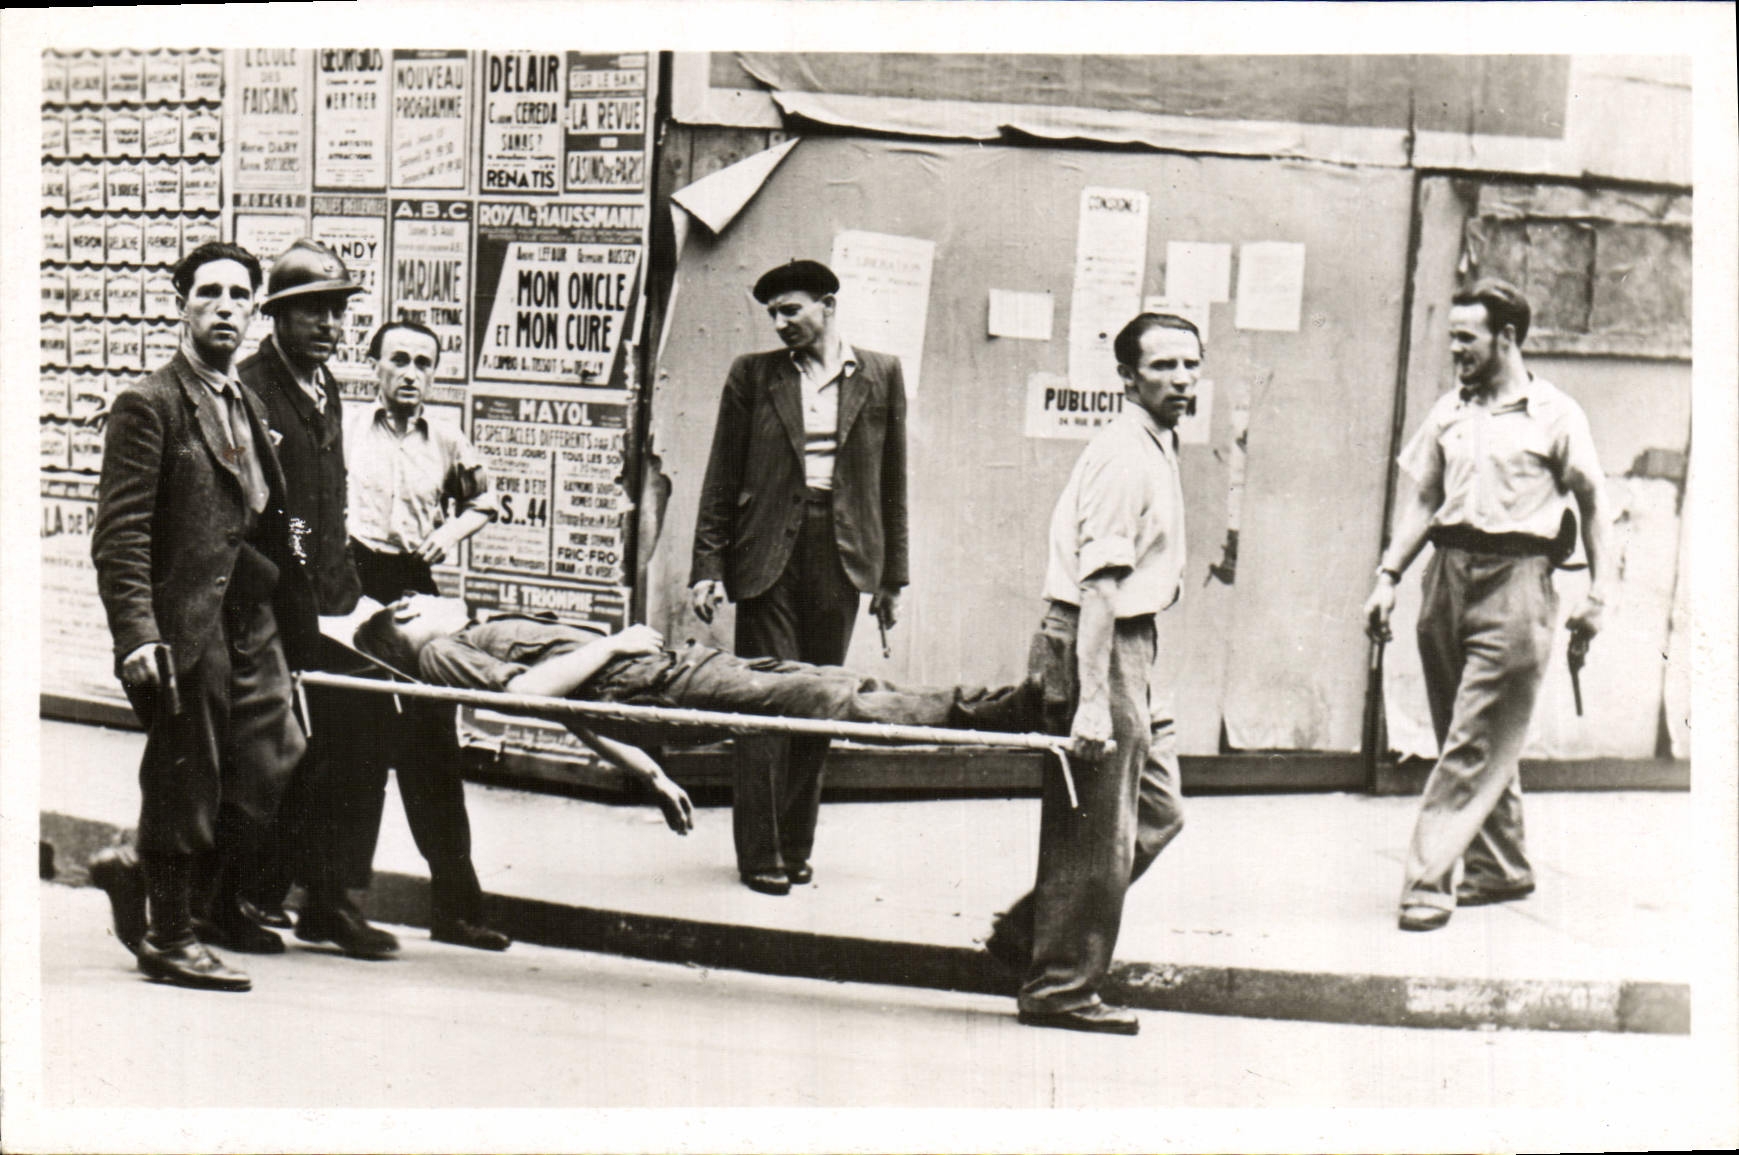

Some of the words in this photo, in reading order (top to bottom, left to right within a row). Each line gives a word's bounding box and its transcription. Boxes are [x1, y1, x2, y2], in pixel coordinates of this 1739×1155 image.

[396, 65, 464, 90] NOUVEAU
[489, 55, 560, 93] DELAIR
[242, 87, 298, 115] FAISANS
[325, 91, 377, 110] WERTHER
[396, 96, 463, 119] PROGRAMME
[515, 101, 558, 125] CEREDA
[572, 101, 589, 131] LA
[597, 100, 641, 131] REVUE
[478, 203, 643, 229] ROYAL-HAUSSMANN
[396, 259, 462, 303] MARJANE
[517, 270, 560, 308] MON
[568, 272, 626, 311] ONCLE
[440, 335, 463, 353] LAR
[495, 324, 510, 347] ET
[516, 311, 559, 349] MON
[565, 313, 613, 353] CURE
[519, 399, 592, 426] MAYOL
[475, 423, 483, 442] 2
[484, 424, 537, 446] SPECTACLES
[539, 428, 592, 450] DIFFERENTS
[477, 444, 501, 457] TOUS
[503, 446, 518, 458] LES
[520, 448, 547, 460] JOURS
[561, 450, 584, 463] TOUS
[586, 452, 603, 464] LES
[40, 503, 64, 539] LA
[67, 513, 83, 535] DE
[497, 493, 547, 528] S..44
[498, 583, 518, 604] LE
